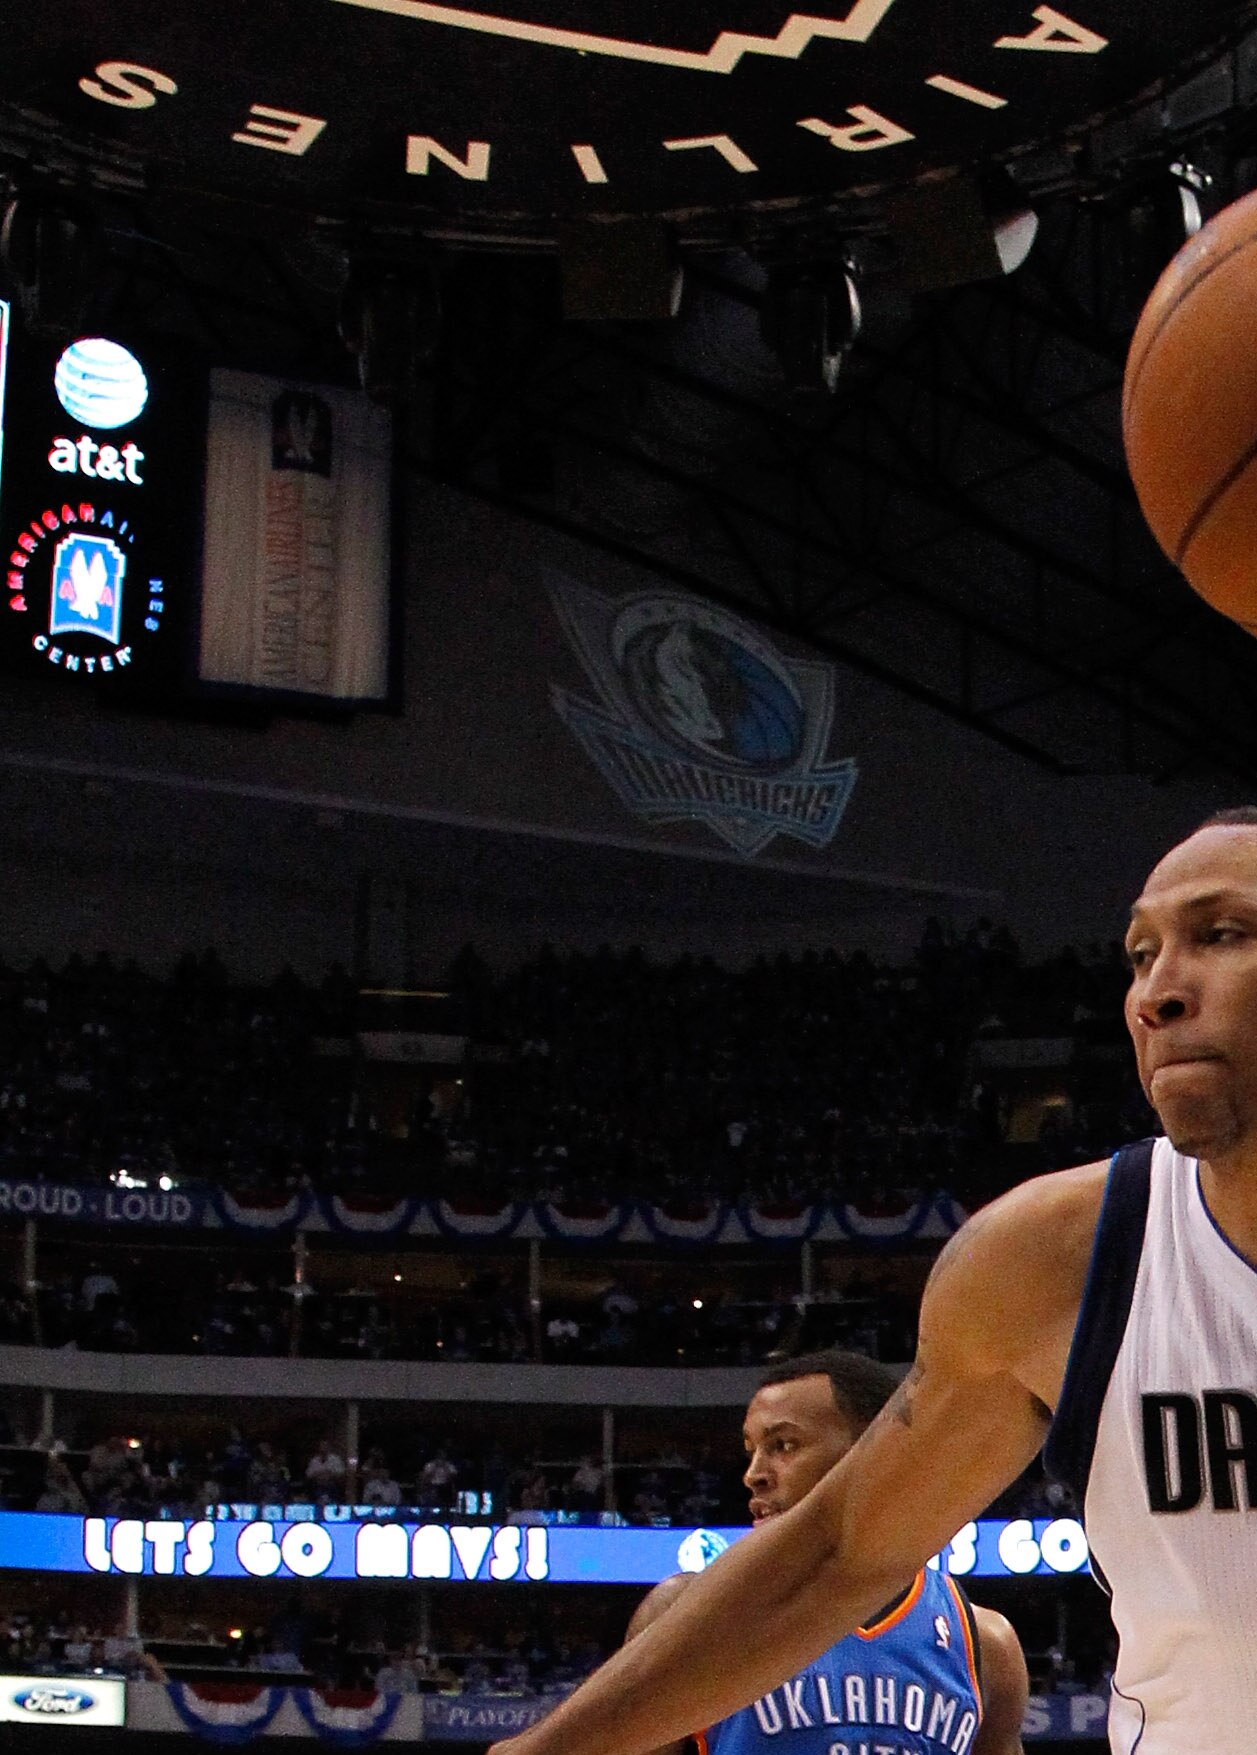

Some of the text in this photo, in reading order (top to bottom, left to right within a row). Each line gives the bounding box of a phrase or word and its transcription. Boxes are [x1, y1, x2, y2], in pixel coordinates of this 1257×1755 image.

[49, 434, 146, 485] at&t
[105, 1193, 192, 1221] LOUD
[83, 1517, 549, 1581] LETS GO MAVS!
[998, 1519, 1089, 1573] GO
[25, 1689, 81, 1714] Ford
